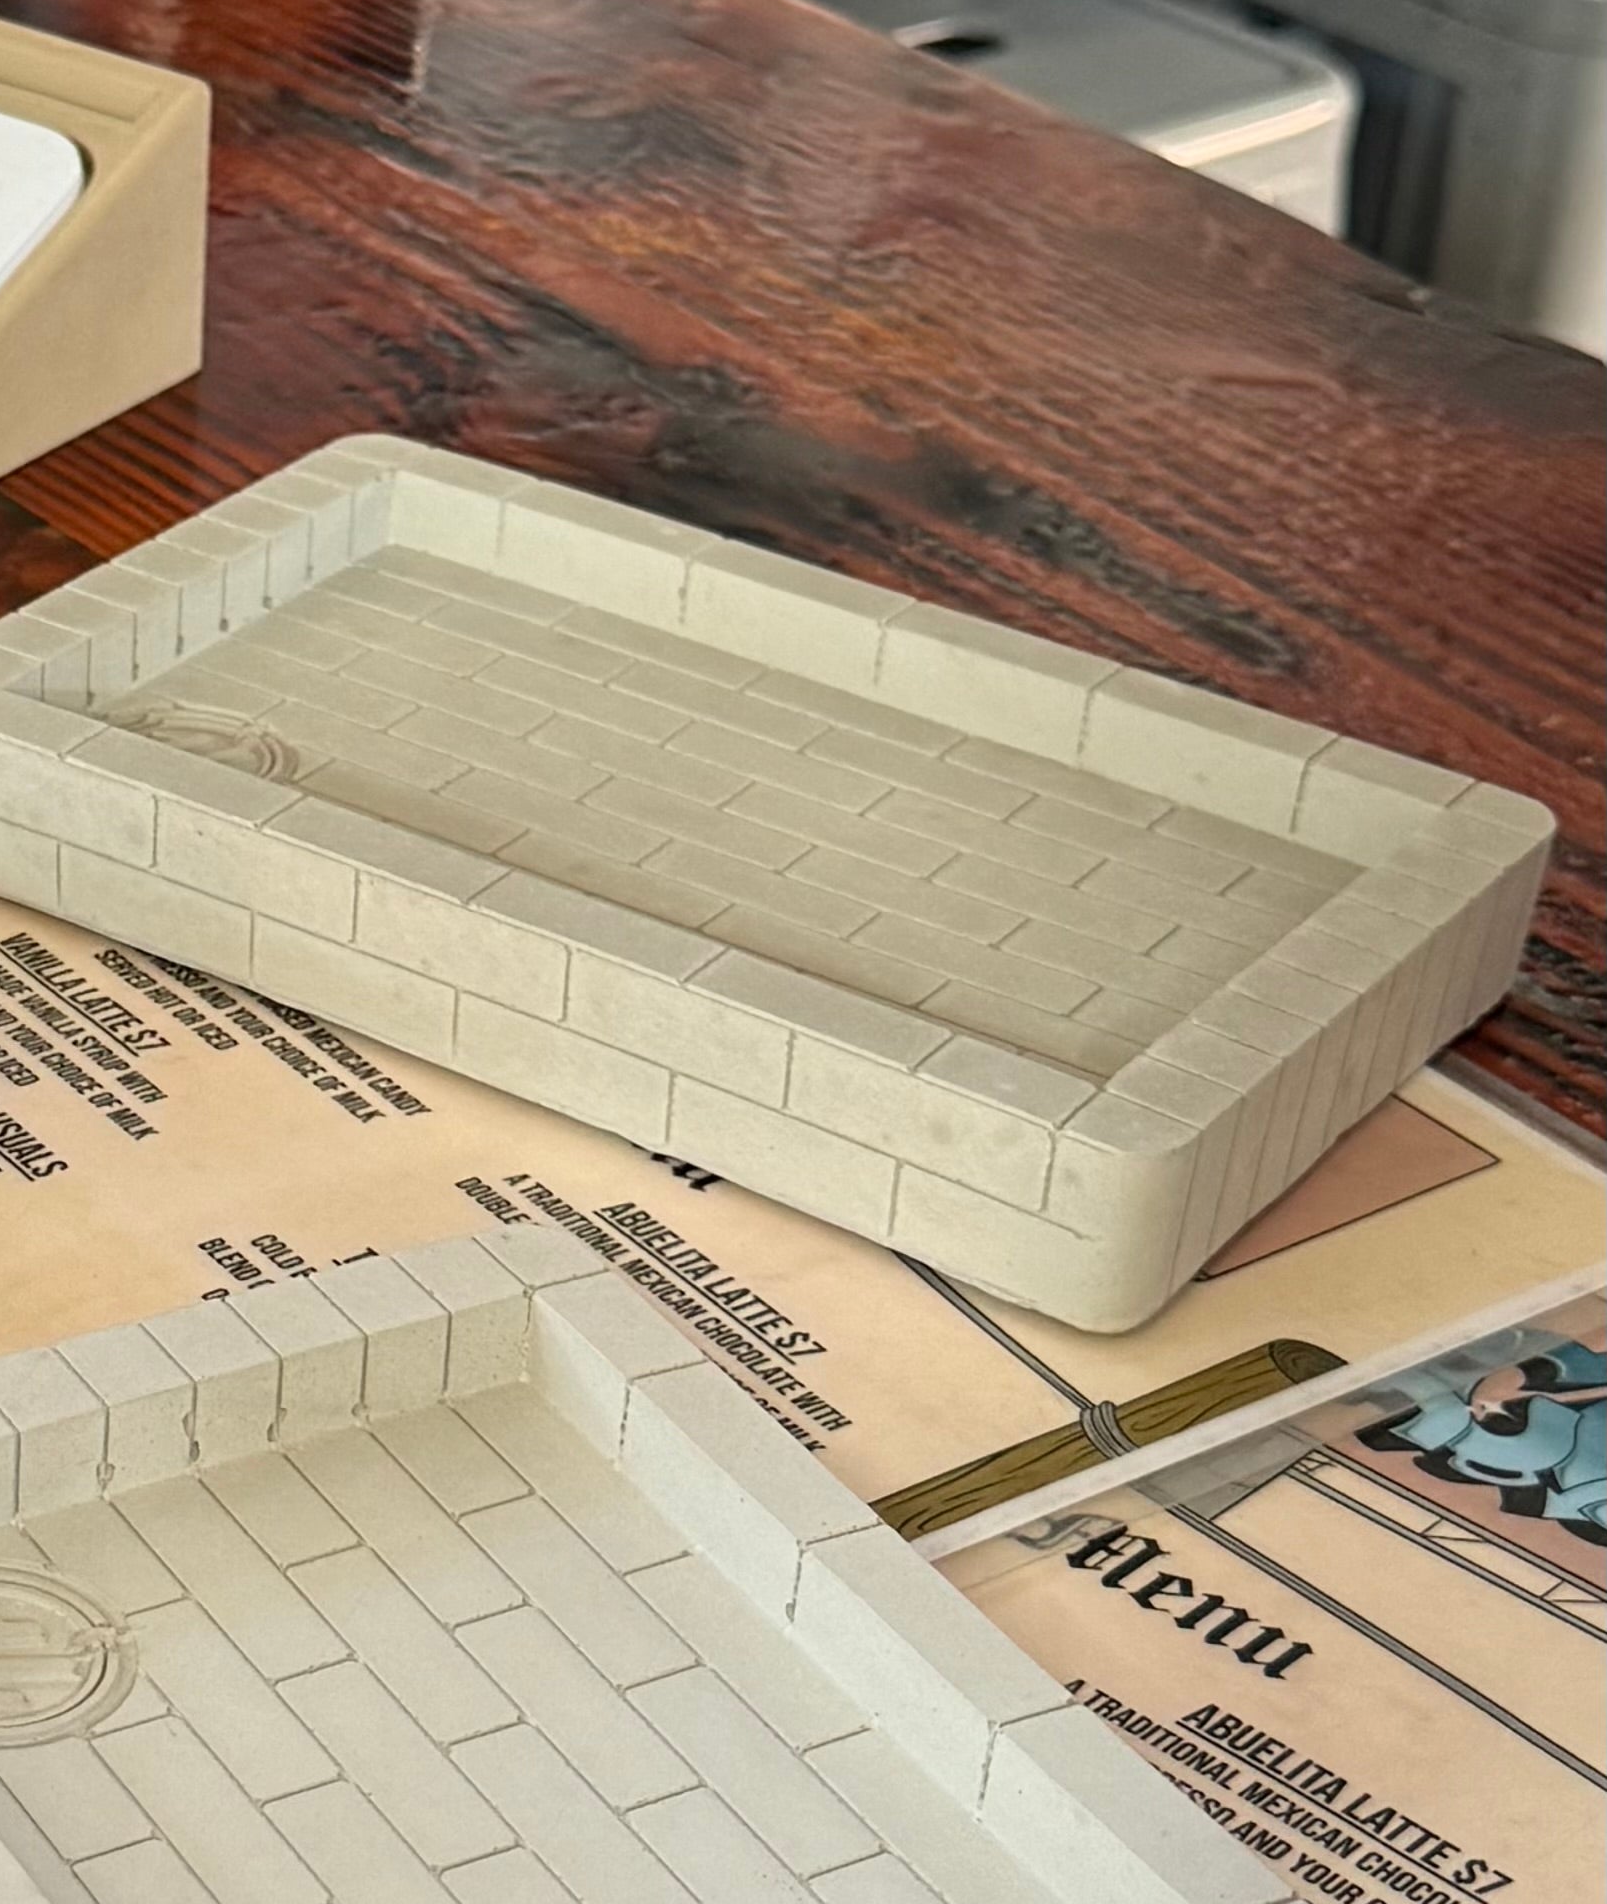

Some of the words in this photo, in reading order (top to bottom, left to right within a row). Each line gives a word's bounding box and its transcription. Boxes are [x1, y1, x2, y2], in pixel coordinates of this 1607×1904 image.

[0, 932, 86, 994] VANILLA
[71, 988, 143, 1034] LATTE
[123, 1028, 172, 1051] $7
[5, 1023, 54, 1056] YOUR
[95, 948, 157, 990] SERVED
[144, 985, 189, 1014] HOT
[172, 1006, 206, 1029] OR
[190, 1018, 239, 1052] ICED
[18, 993, 77, 1040] VANILLA
[71, 1035, 131, 1074] SYRUP
[116, 1069, 168, 1105] WITH
[41, 1051, 103, 1095] CHOICE
[194, 985, 237, 1010] AND
[225, 1007, 276, 1039] YOUR
[262, 1033, 328, 1079] CHOICE
[313, 1076, 348, 1099] OF
[332, 1087, 387, 1124] MILK
[303, 1027, 381, 1081] MEXICAN
[368, 1076, 433, 1117] CANDY
[88, 1091, 123, 1116] OF
[105, 1106, 159, 1141] MILK
[454, 1176, 532, 1225] DOUBLE
[197, 1236, 263, 1282] BLEND
[250, 1233, 302, 1270] COLD
[600, 1201, 720, 1282] ABUELITA
[703, 1275, 794, 1336] LATTE
[775, 1331, 828, 1357] $7
[502, 1173, 531, 1188] A
[519, 1181, 630, 1264] TRADITIONAL
[618, 1258, 709, 1321] MEXICAN
[694, 1315, 806, 1397] CHOCOLATE
[790, 1390, 854, 1433] WITH
[1006, 1512, 1315, 1681] Menu
[1064, 1678, 1086, 1696] A
[1082, 1688, 1241, 1791] TRADITIONAL
[1237, 1780, 1364, 1859] MEXICAN
[1181, 1702, 1349, 1807] ABUELITA
[1341, 1792, 1462, 1870] LATTE
[1451, 1857, 1516, 1896] $7
[1229, 1820, 1294, 1861] AND
